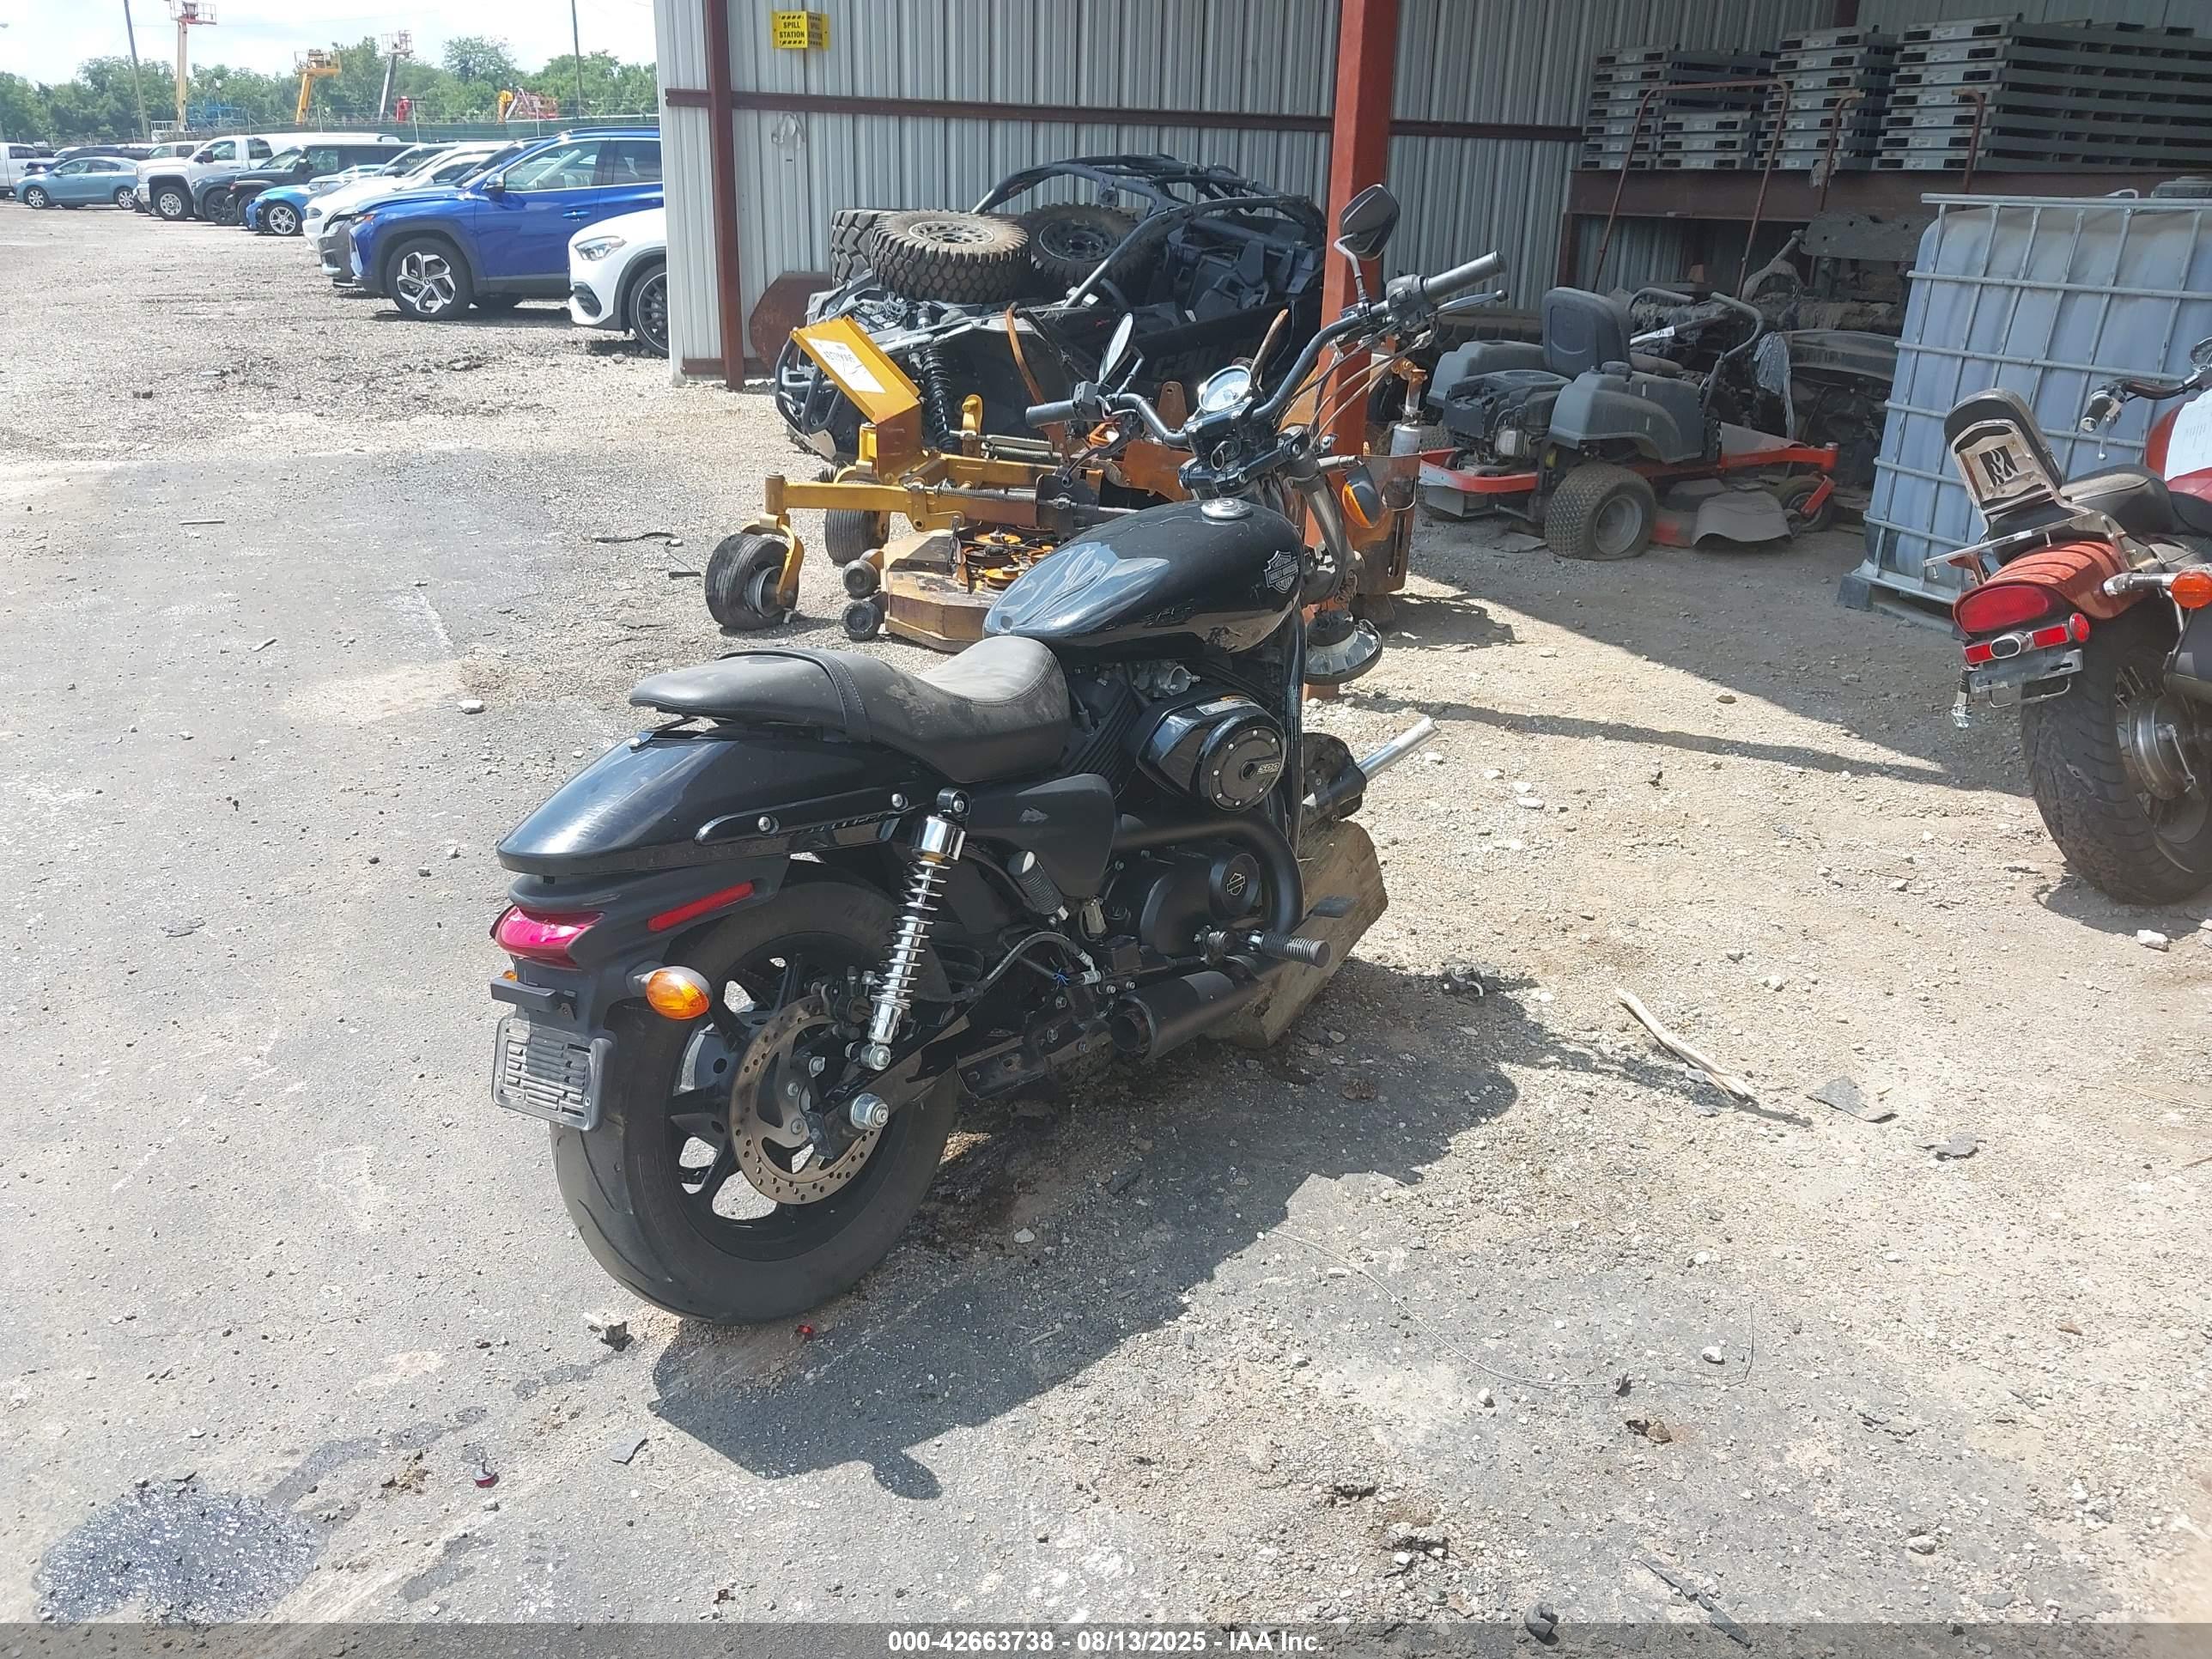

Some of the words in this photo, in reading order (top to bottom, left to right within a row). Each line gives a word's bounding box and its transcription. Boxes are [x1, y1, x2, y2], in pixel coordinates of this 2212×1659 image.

[783, 21, 800, 29] SPILL
[779, 30, 805, 39] STATION
[1258, 763, 1280, 771] 500
